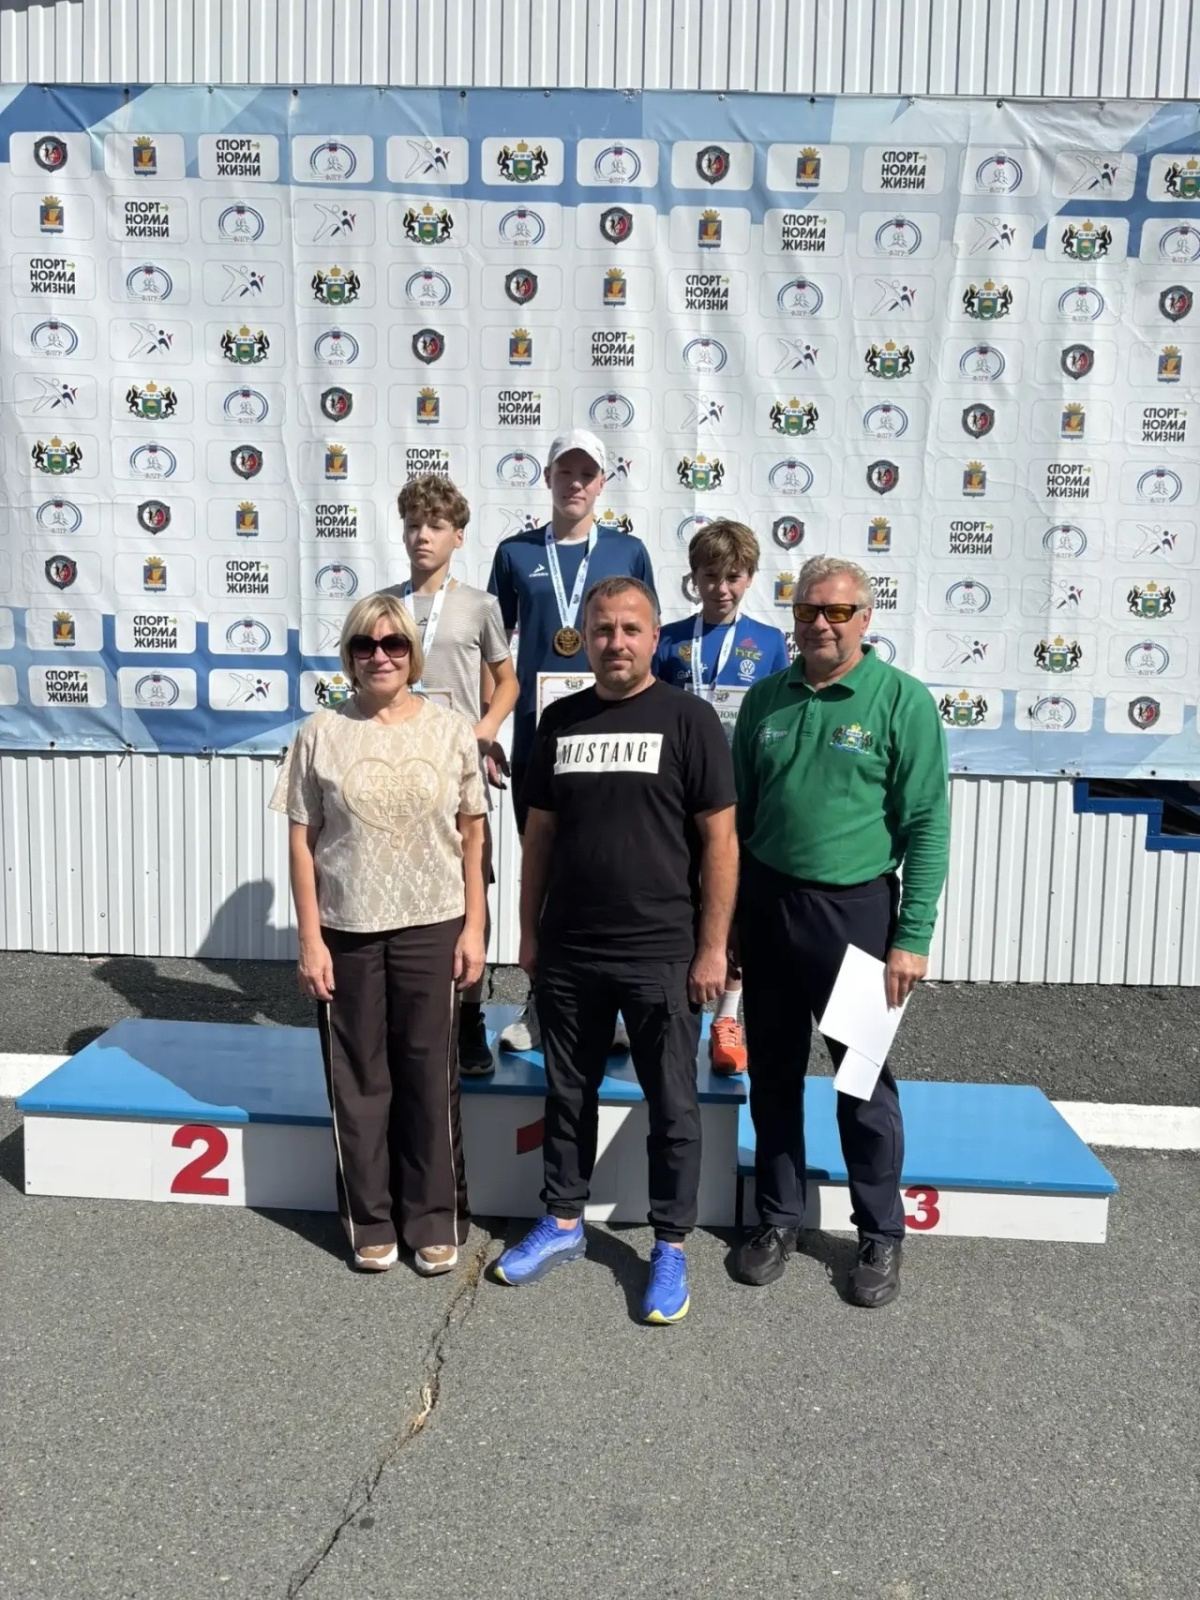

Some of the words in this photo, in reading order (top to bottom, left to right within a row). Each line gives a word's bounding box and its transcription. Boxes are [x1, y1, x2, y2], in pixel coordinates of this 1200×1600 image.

[216, 140, 252, 150] СПОРТ
[217, 152, 260, 163] НОРМА
[882, 151, 919, 163] СПОРТ
[218, 164, 260, 176] ЖИЗНИ
[882, 164, 926, 176] НОРМА
[881, 177, 925, 189] ЖИЗНИ
[125, 202, 160, 213] СПОРТ
[126, 214, 168, 225] НОРМА
[783, 215, 819, 226] СПОРТ
[126, 226, 169, 237] ЖИЗНИ
[782, 227, 825, 239] НОРМА
[781, 240, 825, 251] ЖИЗНИ
[30, 259, 67, 269] СПОРТ
[30, 270, 75, 282] НОРМА
[686, 275, 721, 286] СПОРТ
[31, 282, 75, 294] ЖИЗНИ
[686, 287, 728, 298] НОРМА
[686, 299, 728, 310] ЖИЗНИ
[592, 332, 627, 342] СПОРТ
[592, 344, 634, 354] НОРМА
[592, 355, 634, 366] ЖИЗНИ
[498, 391, 533, 401] СПОРТ
[498, 403, 540, 413] НОРМА
[1144, 408, 1180, 418] СПОРТ
[499, 414, 540, 425] ЖИЗНИ
[1143, 420, 1186, 430] НОРМА
[1142, 431, 1185, 441] ЖИЗНИ
[406, 448, 441, 459] СПОРТ
[406, 460, 449, 471] НОРМА
[1047, 464, 1082, 474] СПОРТ
[1047, 475, 1089, 486] НОРМА
[1046, 487, 1089, 497] ЖИЗНИ
[315, 505, 348, 515] СПОРТ
[316, 516, 356, 526] НОРМА
[950, 521, 985, 531] СПОРТ
[316, 528, 356, 537] ЖИЗНИ
[950, 533, 992, 543] НОРМА
[950, 544, 992, 554] ЖИЗНИ
[226, 561, 260, 571] СПОРТ
[227, 572, 268, 582] НОРМА
[869, 577, 890, 587] ОРТ
[227, 583, 268, 593] ЖИЗНИ
[872, 599, 897, 609] ЗНИ
[134, 616, 169, 625] СПОРТ
[134, 627, 176, 637] НОРМА
[135, 638, 176, 648] ЖИЗНИ
[46, 671, 80, 680] СПОРТ
[46, 682, 87, 691] НОРМА
[48, 692, 88, 703] ЖИЗНИ
[170, 1123, 229, 1197] 2
[902, 1184, 940, 1230] 3
